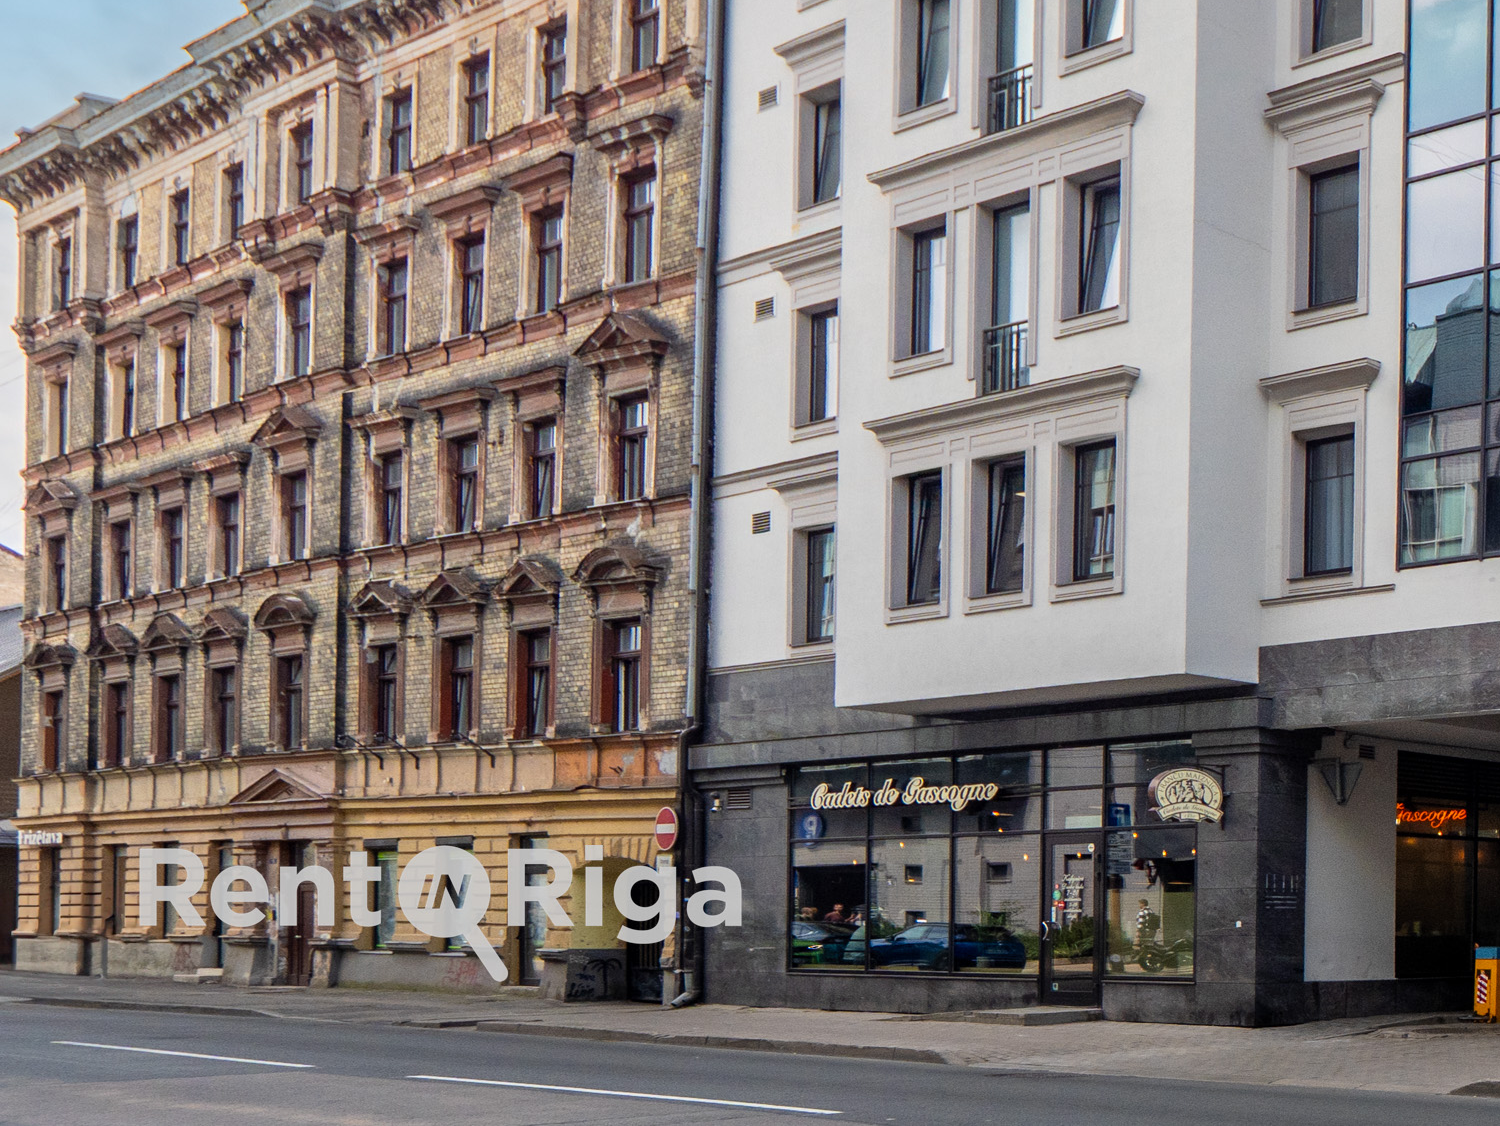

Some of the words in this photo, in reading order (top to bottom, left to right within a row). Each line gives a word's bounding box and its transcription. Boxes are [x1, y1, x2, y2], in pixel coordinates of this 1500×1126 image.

[811, 781, 871, 810] Cadets
[873, 778, 900, 806] de
[902, 776, 999, 812] Gascogne
